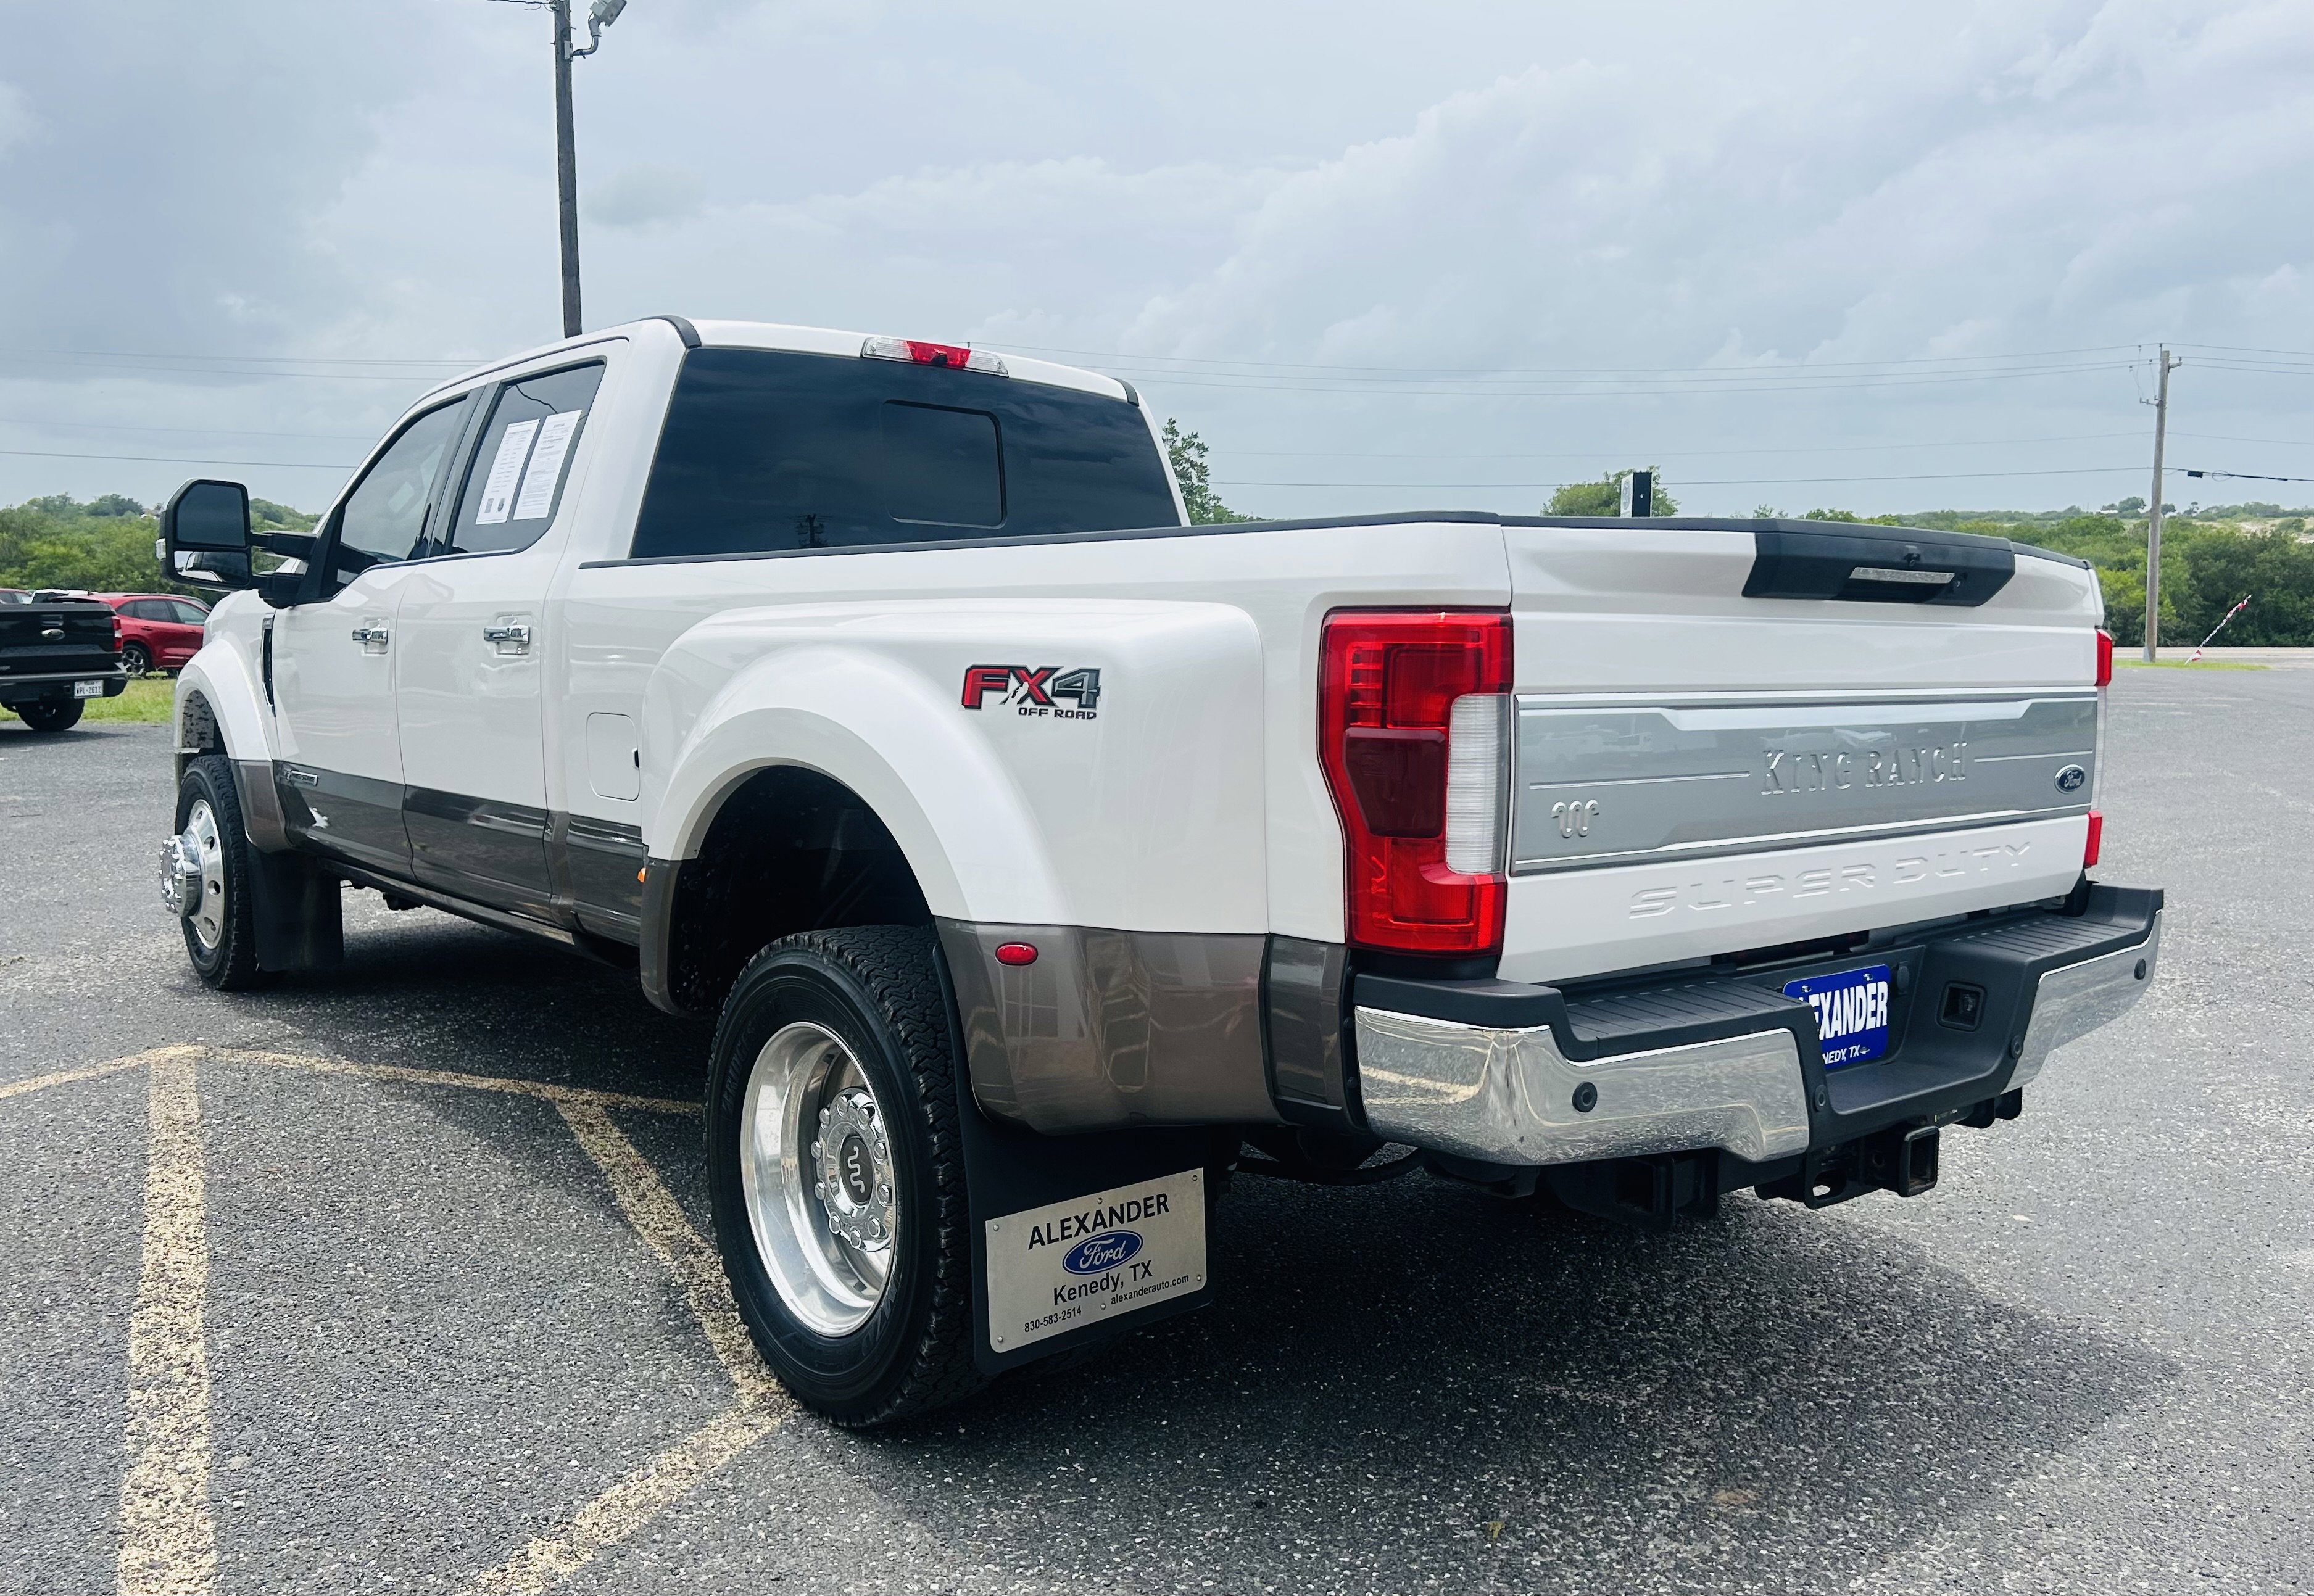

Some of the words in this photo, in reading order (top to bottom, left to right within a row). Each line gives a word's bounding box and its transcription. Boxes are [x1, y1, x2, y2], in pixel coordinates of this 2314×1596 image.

[961, 664, 1101, 711] FX4
[1018, 706, 1049, 717] OFF
[1053, 709, 1098, 720] ROAD
[1760, 750, 1851, 795] KING
[1865, 741, 1968, 788] RANCH
[1628, 863, 1875, 919] SUPER
[1893, 841, 2031, 883] DUTY
[1798, 981, 1889, 1041] EXANDER
[1822, 1048, 1847, 1064] NEDY,
[1849, 1044, 1861, 1058] TX
[1027, 1193, 1170, 1250] ALEXANDER
[1079, 1238, 1127, 1269] Ford
[1053, 1271, 1124, 1306] Kenedy,
[1129, 1259, 1153, 1281] TX
[1110, 1273, 1190, 1305] alexanderauto.com
[1024, 1305, 1082, 1333] 830-583-2514
